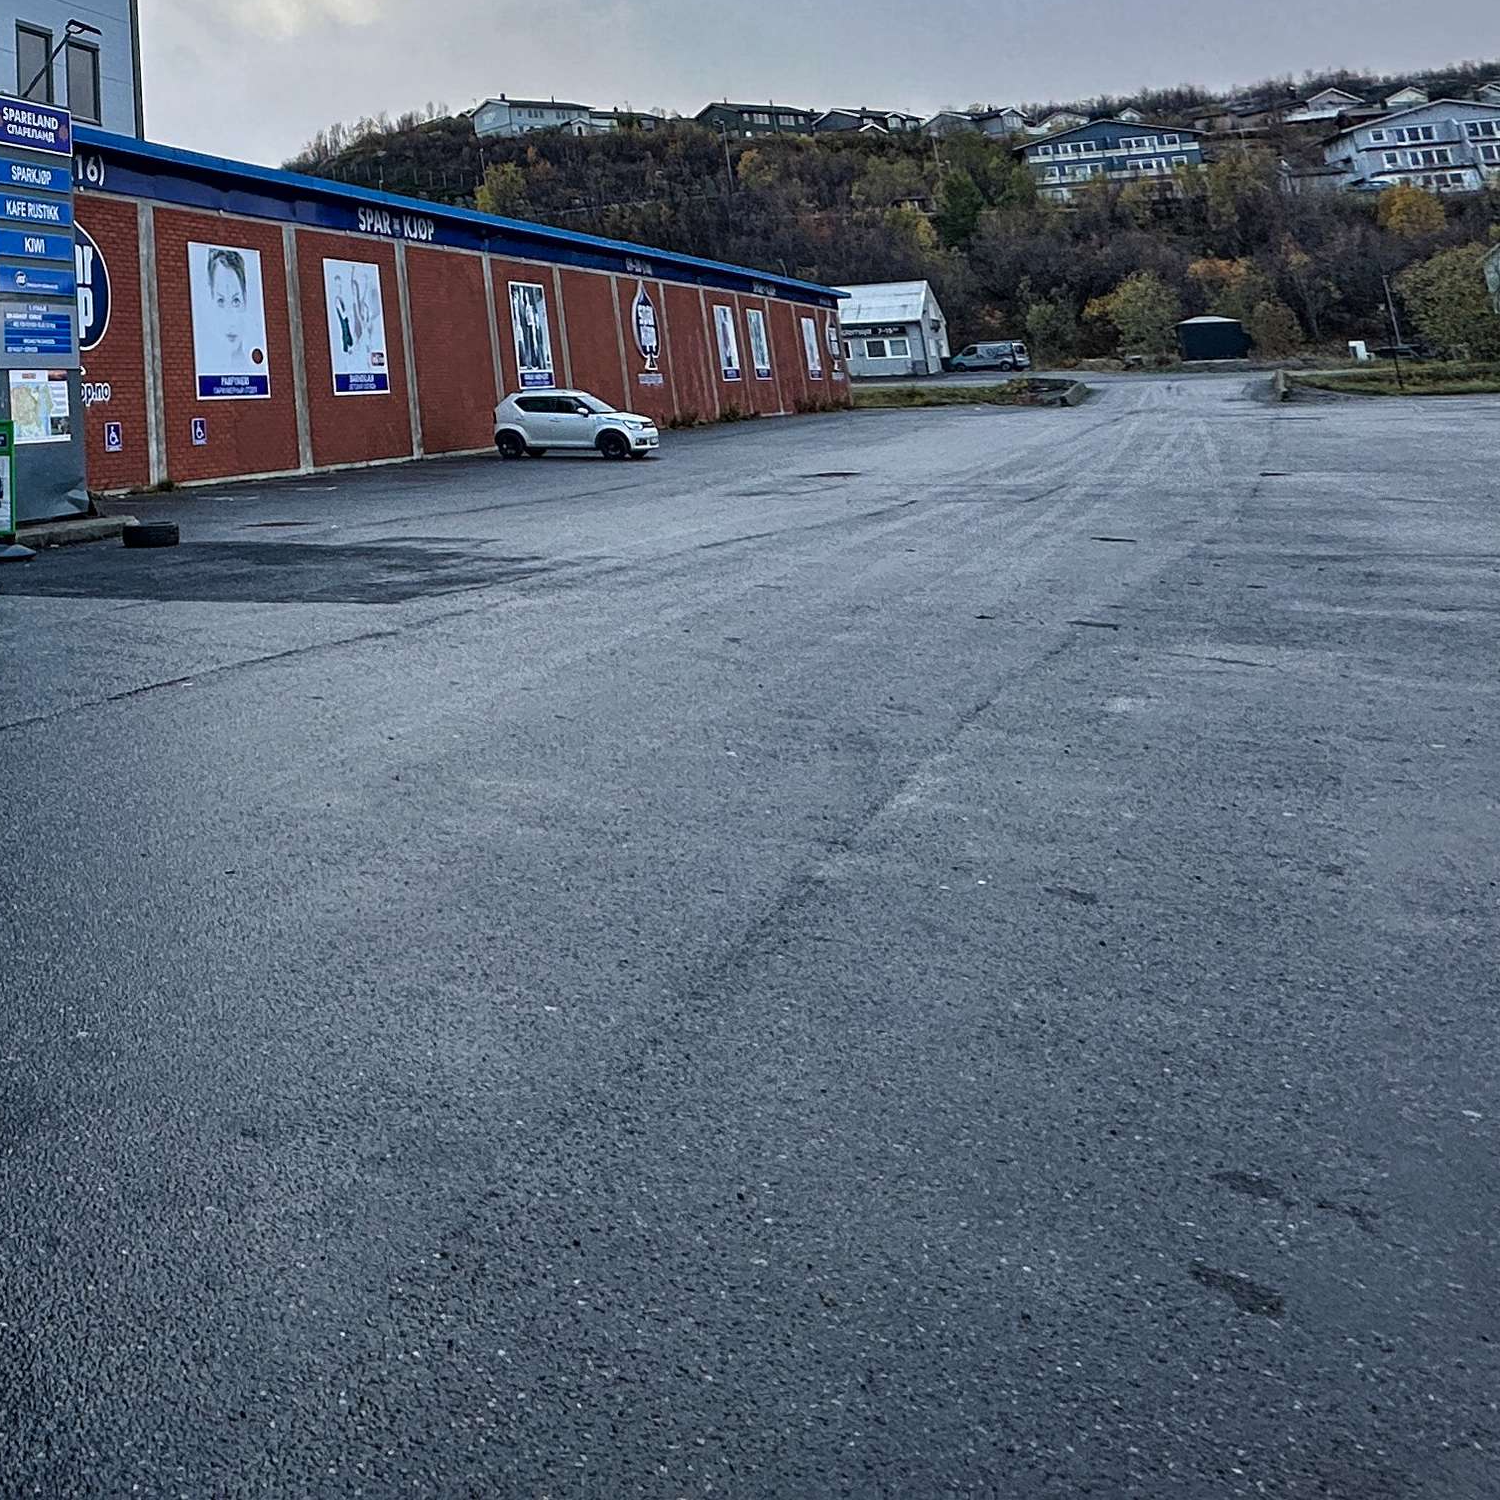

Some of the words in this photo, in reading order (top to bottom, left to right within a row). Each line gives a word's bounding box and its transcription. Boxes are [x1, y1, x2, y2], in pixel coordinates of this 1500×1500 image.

[2, 106, 58, 130] SPARELAND
[11, 165, 52, 185] SPARKJØP
[5, 199, 27, 217] KAFE
[357, 207, 392, 235] SPAR
[402, 214, 435, 241] KJØP
[24, 236, 46, 254] KIWI
